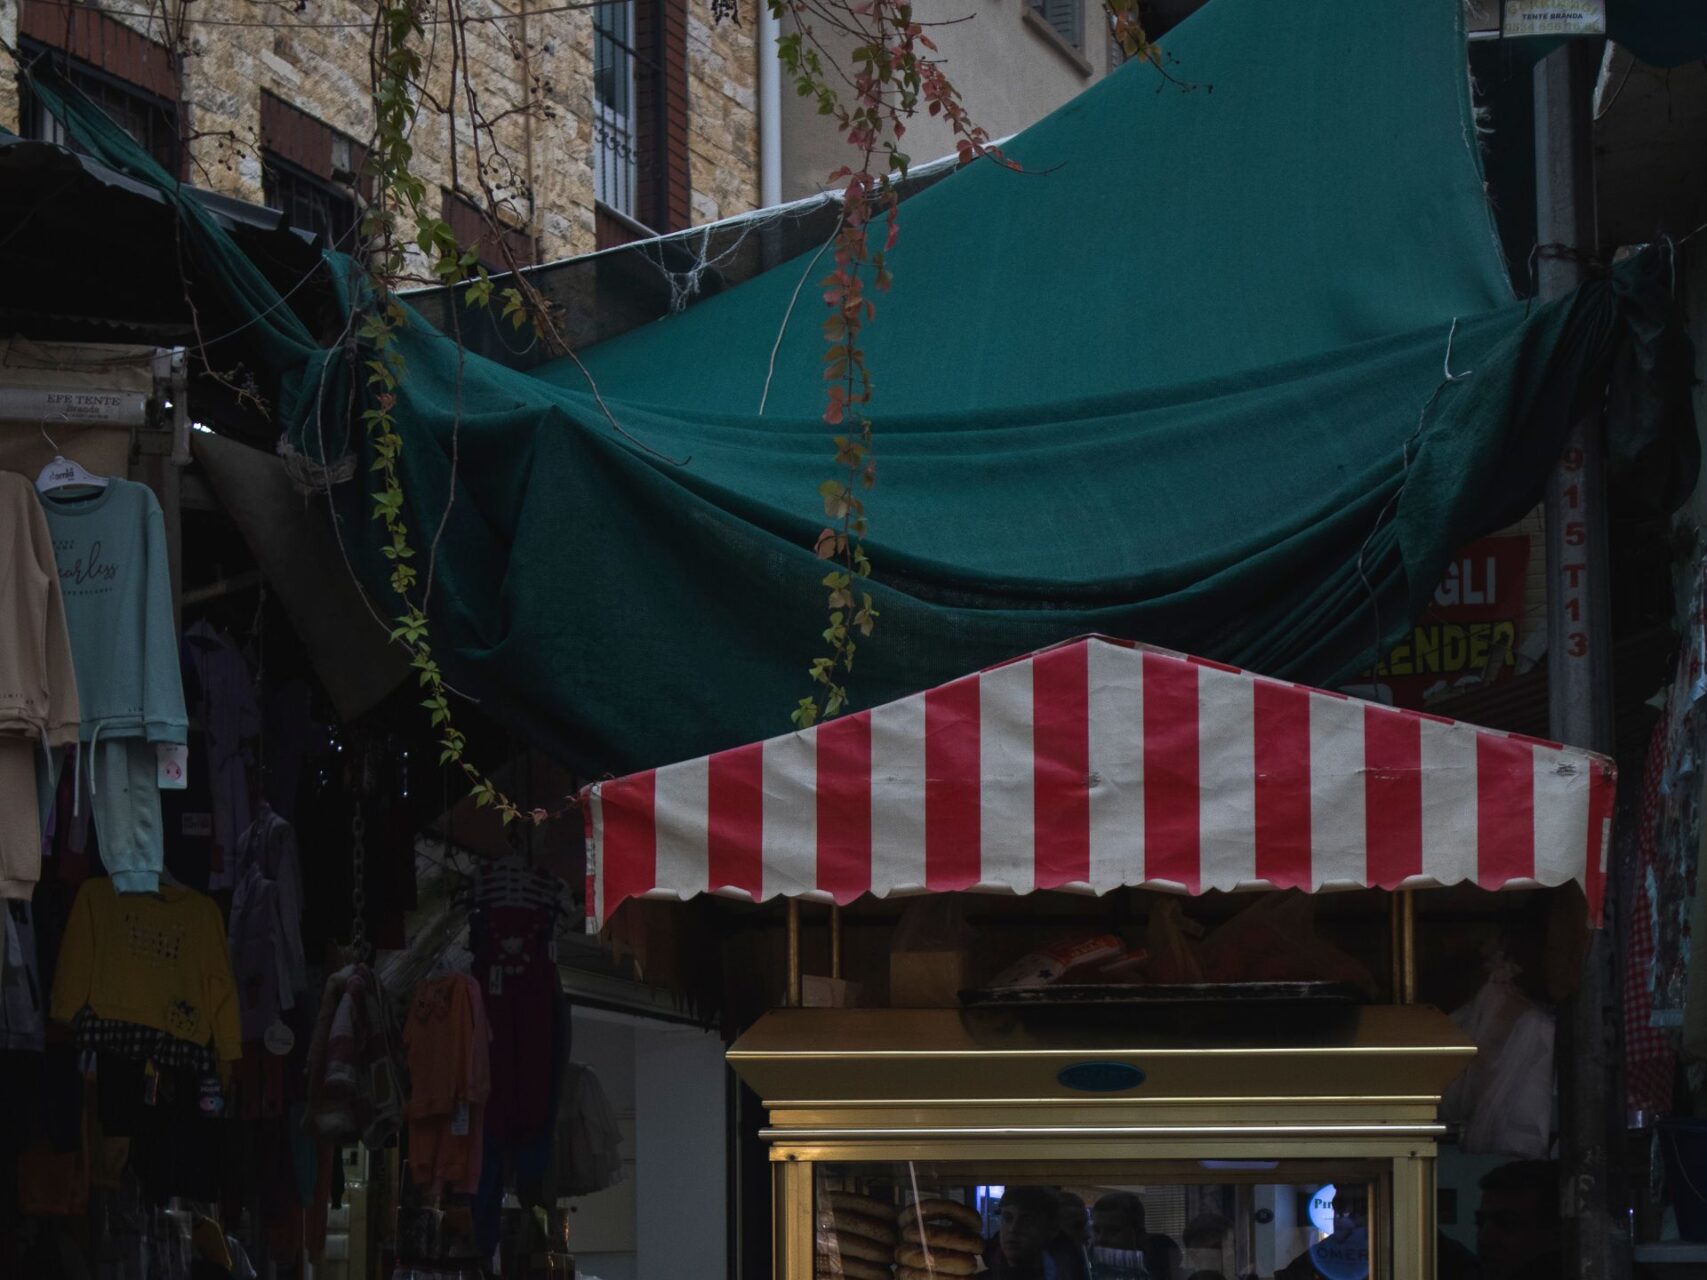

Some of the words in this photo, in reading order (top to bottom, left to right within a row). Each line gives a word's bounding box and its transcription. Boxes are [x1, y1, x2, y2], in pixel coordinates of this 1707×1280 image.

[47, 393, 73, 404] EFE
[75, 395, 121, 406] TENTE
[56, 540, 118, 585] earless
